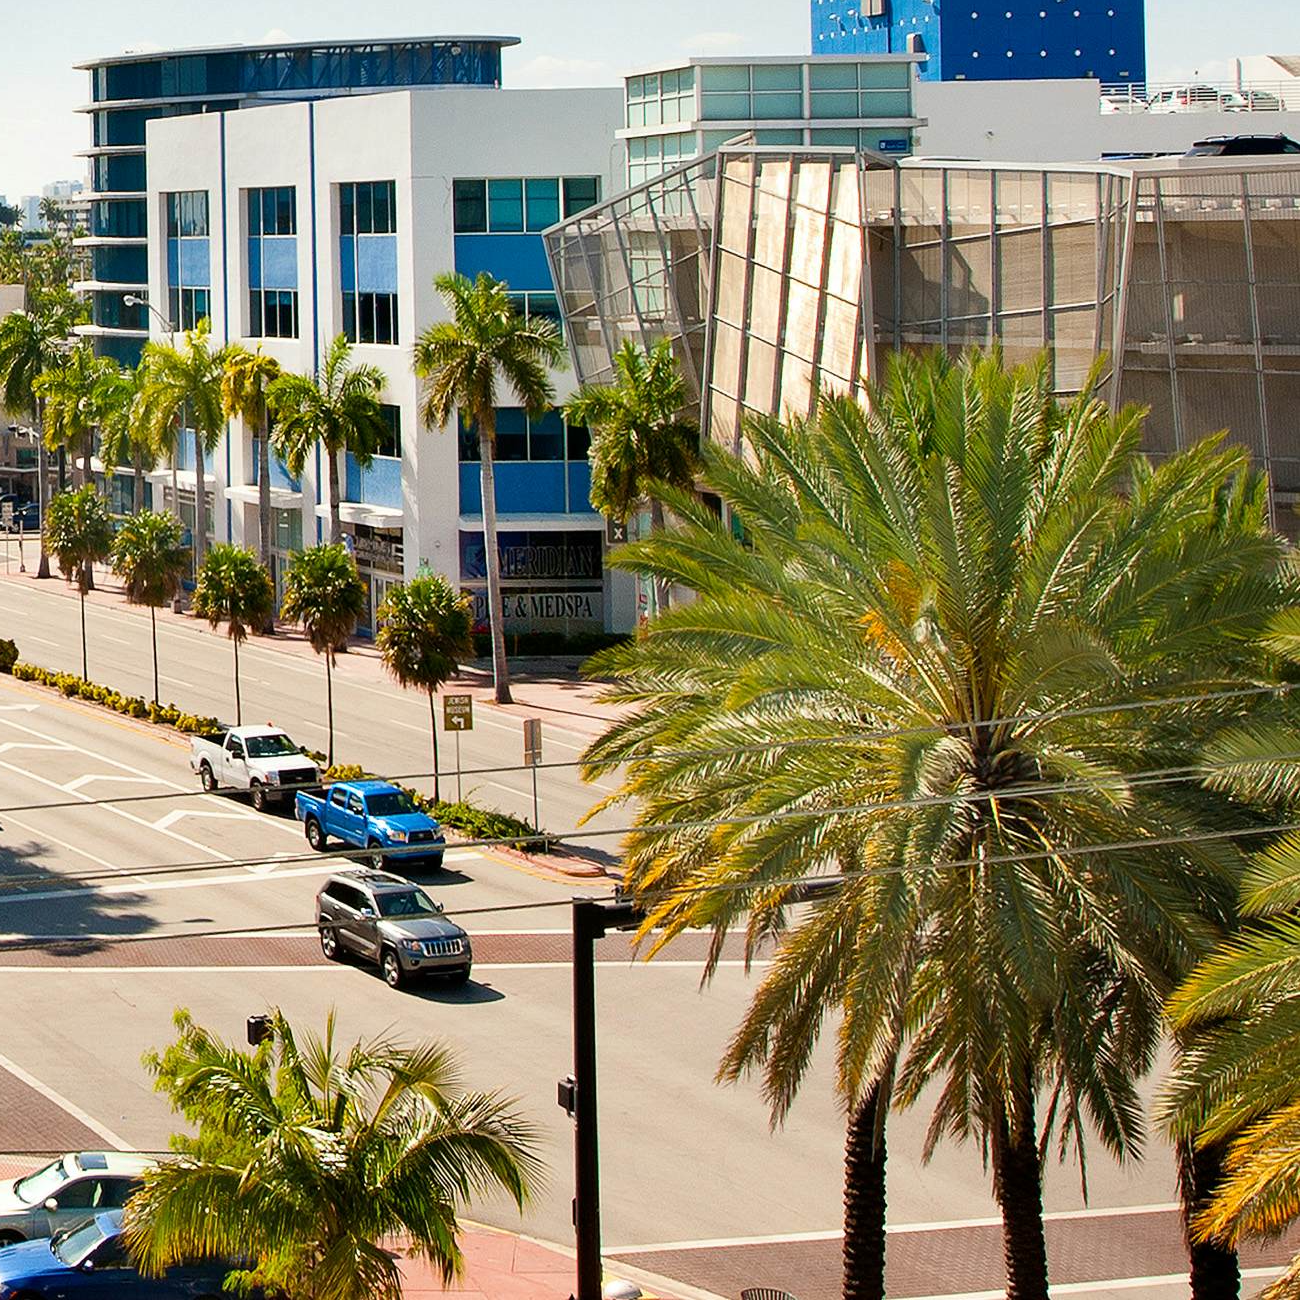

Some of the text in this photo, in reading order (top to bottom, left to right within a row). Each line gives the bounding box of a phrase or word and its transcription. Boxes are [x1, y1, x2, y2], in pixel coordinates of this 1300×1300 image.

[497, 546, 594, 576] MERIDIAN
[514, 595, 527, 618] &
[530, 594, 593, 618] MEDSPA
